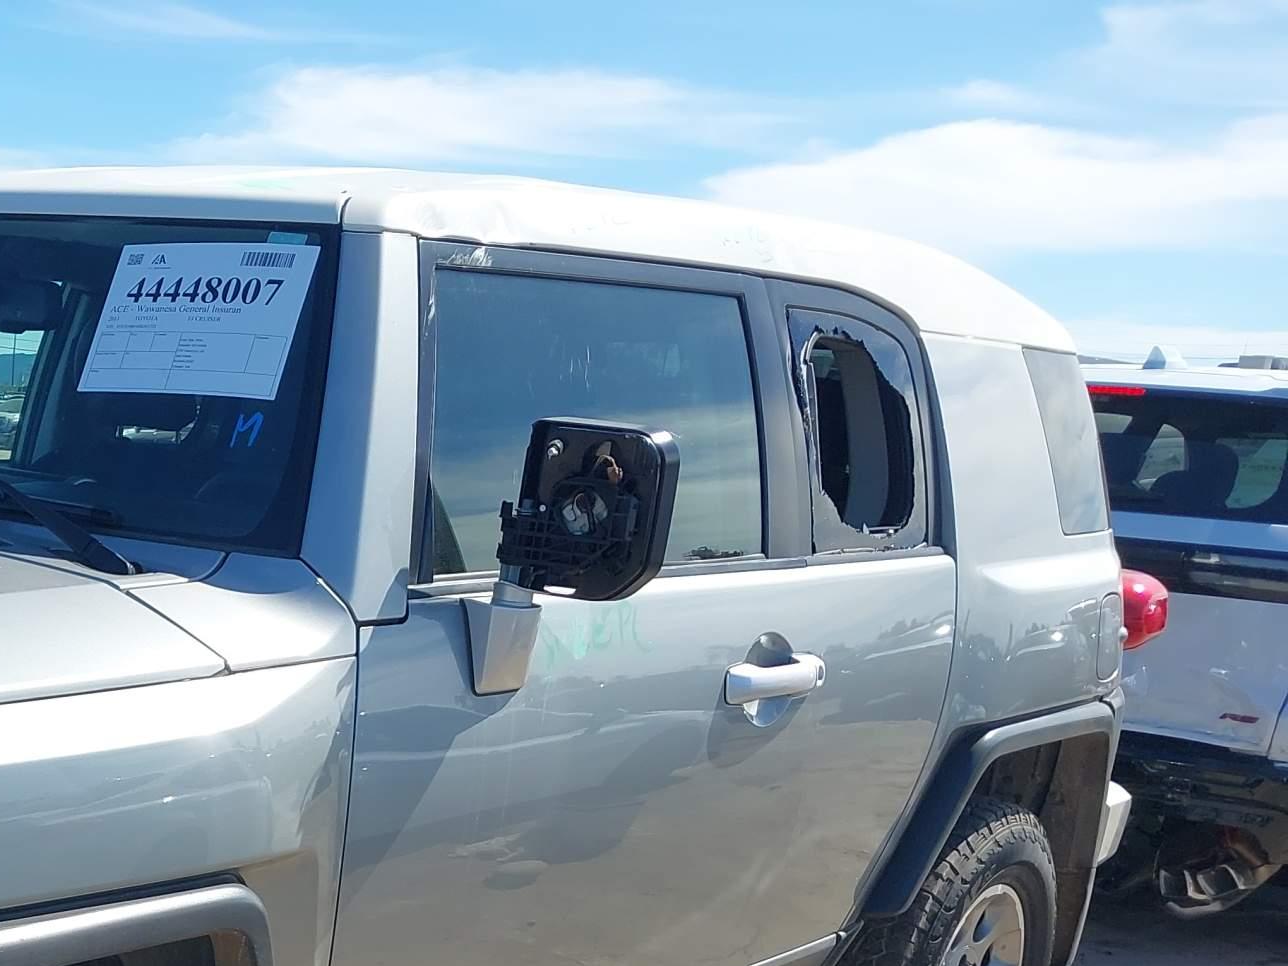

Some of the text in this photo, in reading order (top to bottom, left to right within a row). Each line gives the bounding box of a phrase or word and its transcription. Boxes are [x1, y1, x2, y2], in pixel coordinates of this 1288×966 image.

[126, 276, 285, 306] 44448007
[110, 305, 130, 313] ACE
[178, 304, 210, 313] General
